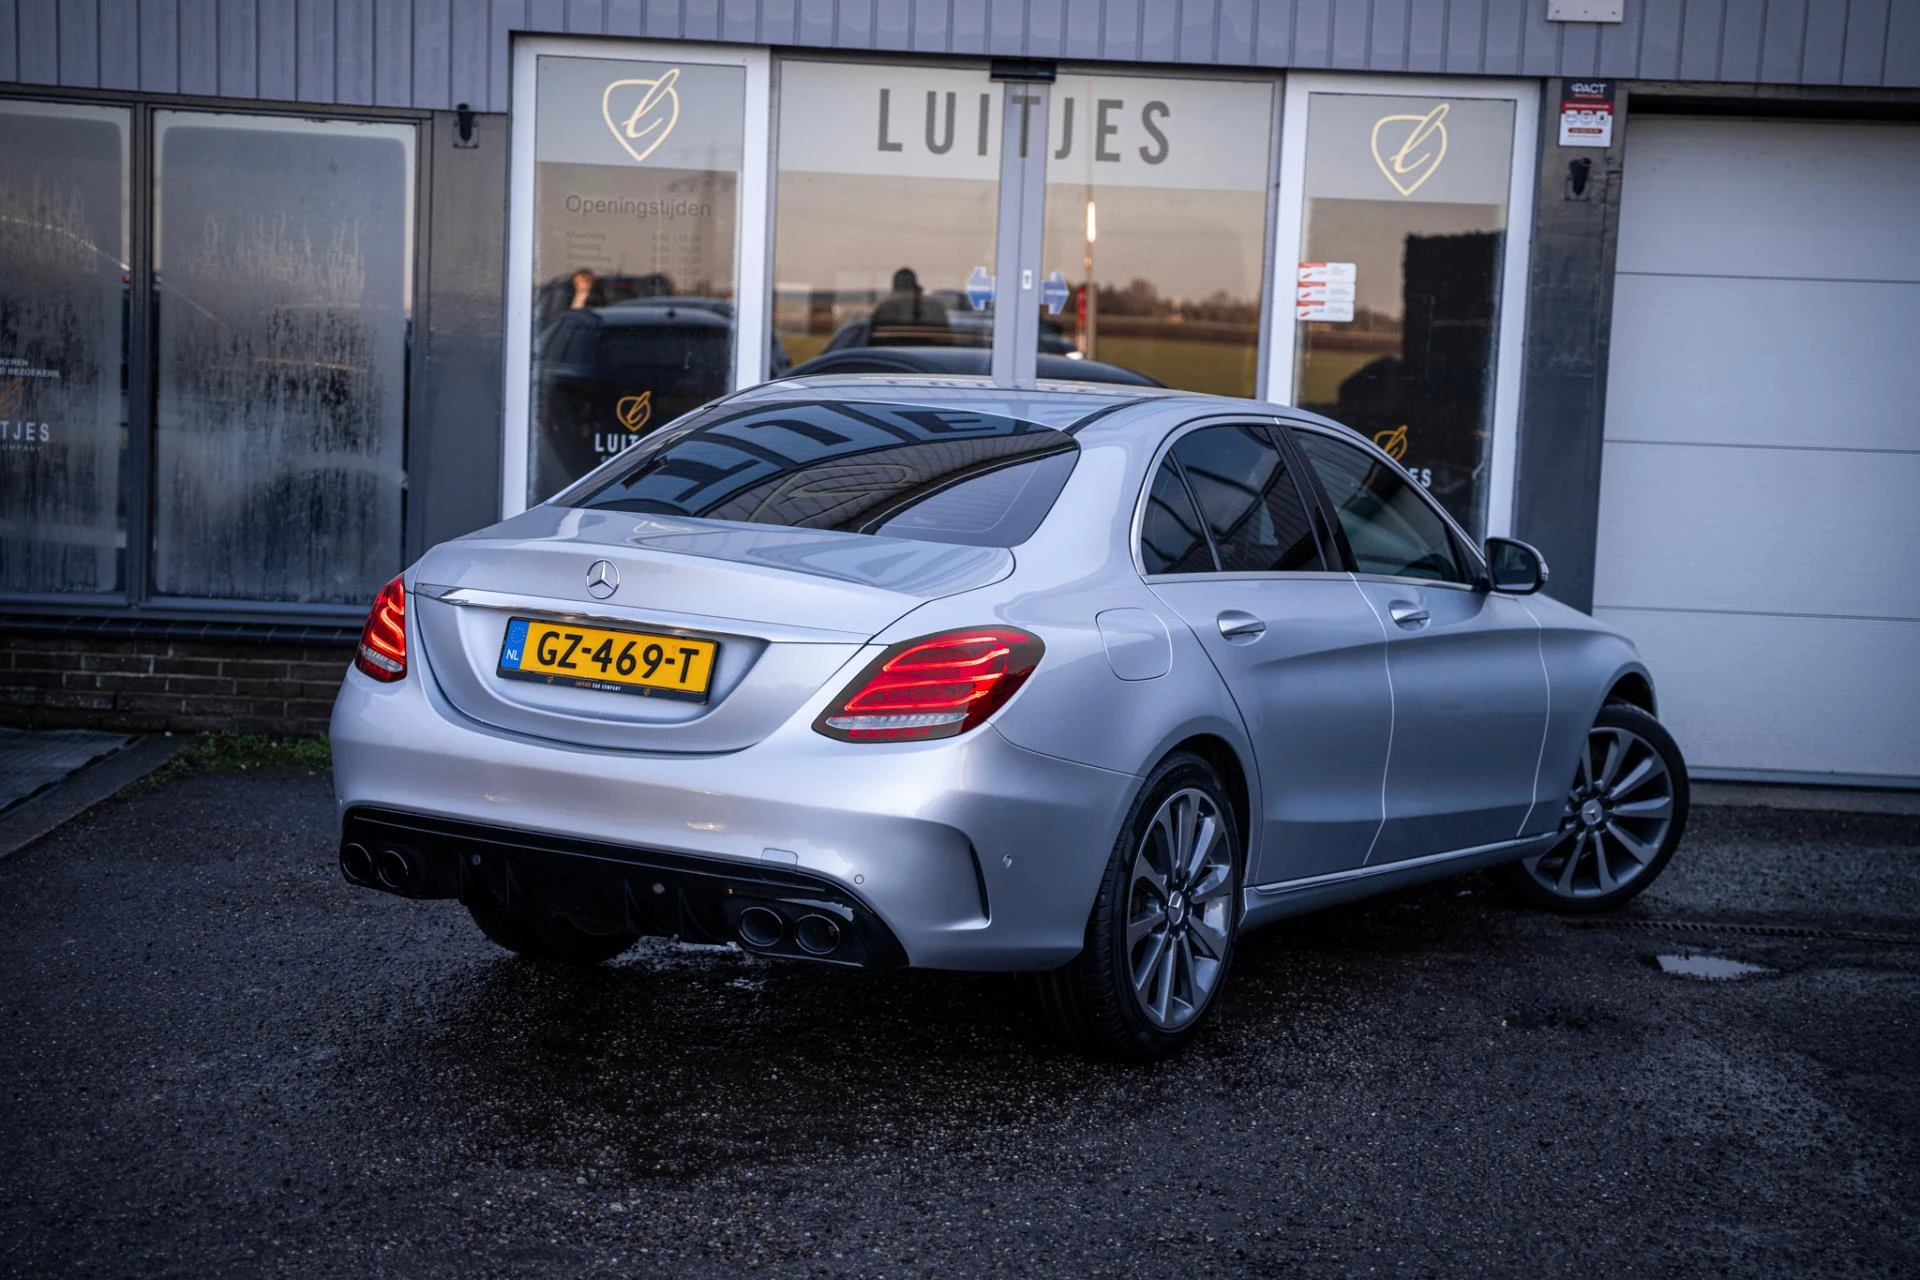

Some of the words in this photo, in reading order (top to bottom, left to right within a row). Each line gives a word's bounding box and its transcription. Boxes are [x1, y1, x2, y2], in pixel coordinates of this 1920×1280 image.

[877, 87, 1171, 165] LUITJES
[565, 194, 712, 220] Openingstijden
[0, 421, 50, 442] TJES
[594, 432, 640, 453] LUIT
[505, 648, 520, 661] NL
[536, 631, 700, 683] GZ-469-T
